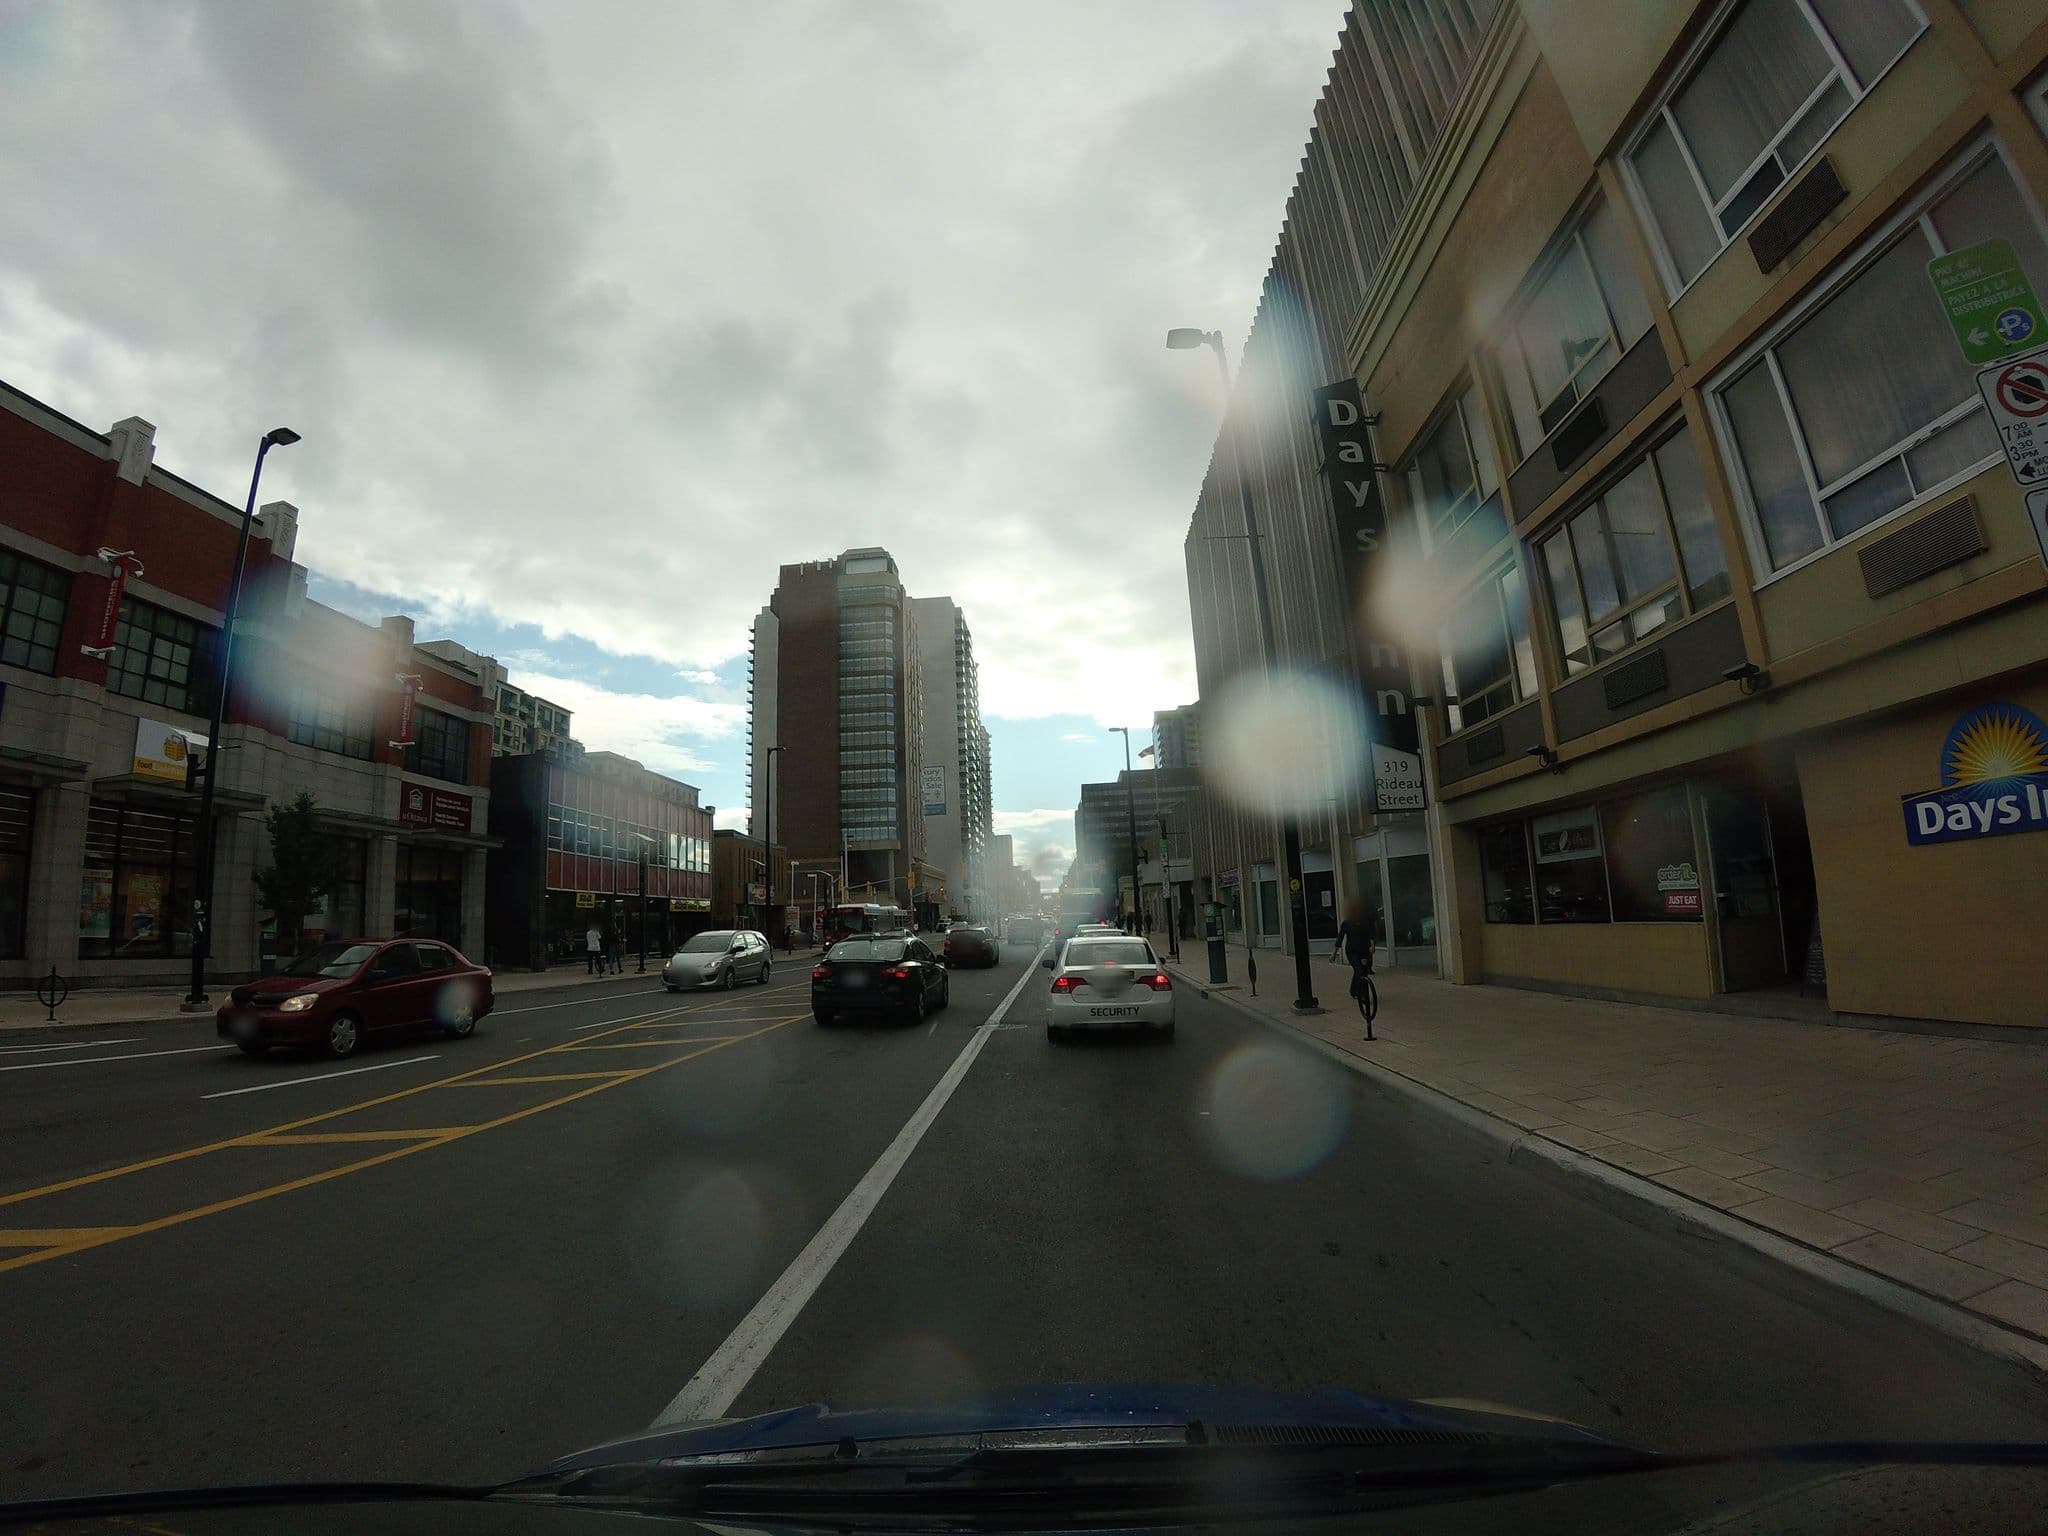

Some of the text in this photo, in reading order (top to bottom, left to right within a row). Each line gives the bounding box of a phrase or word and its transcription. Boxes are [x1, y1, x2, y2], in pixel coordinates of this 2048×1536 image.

[137, 759, 153, 770] food
[1384, 760, 1408, 773] 319
[1376, 777, 1423, 790] Rideau
[1379, 793, 1420, 806] Street
[1916, 783, 2048, 836] Days I
[1668, 895, 1697, 905] JUST EAT
[1090, 1006, 1140, 1017] SECURITY
